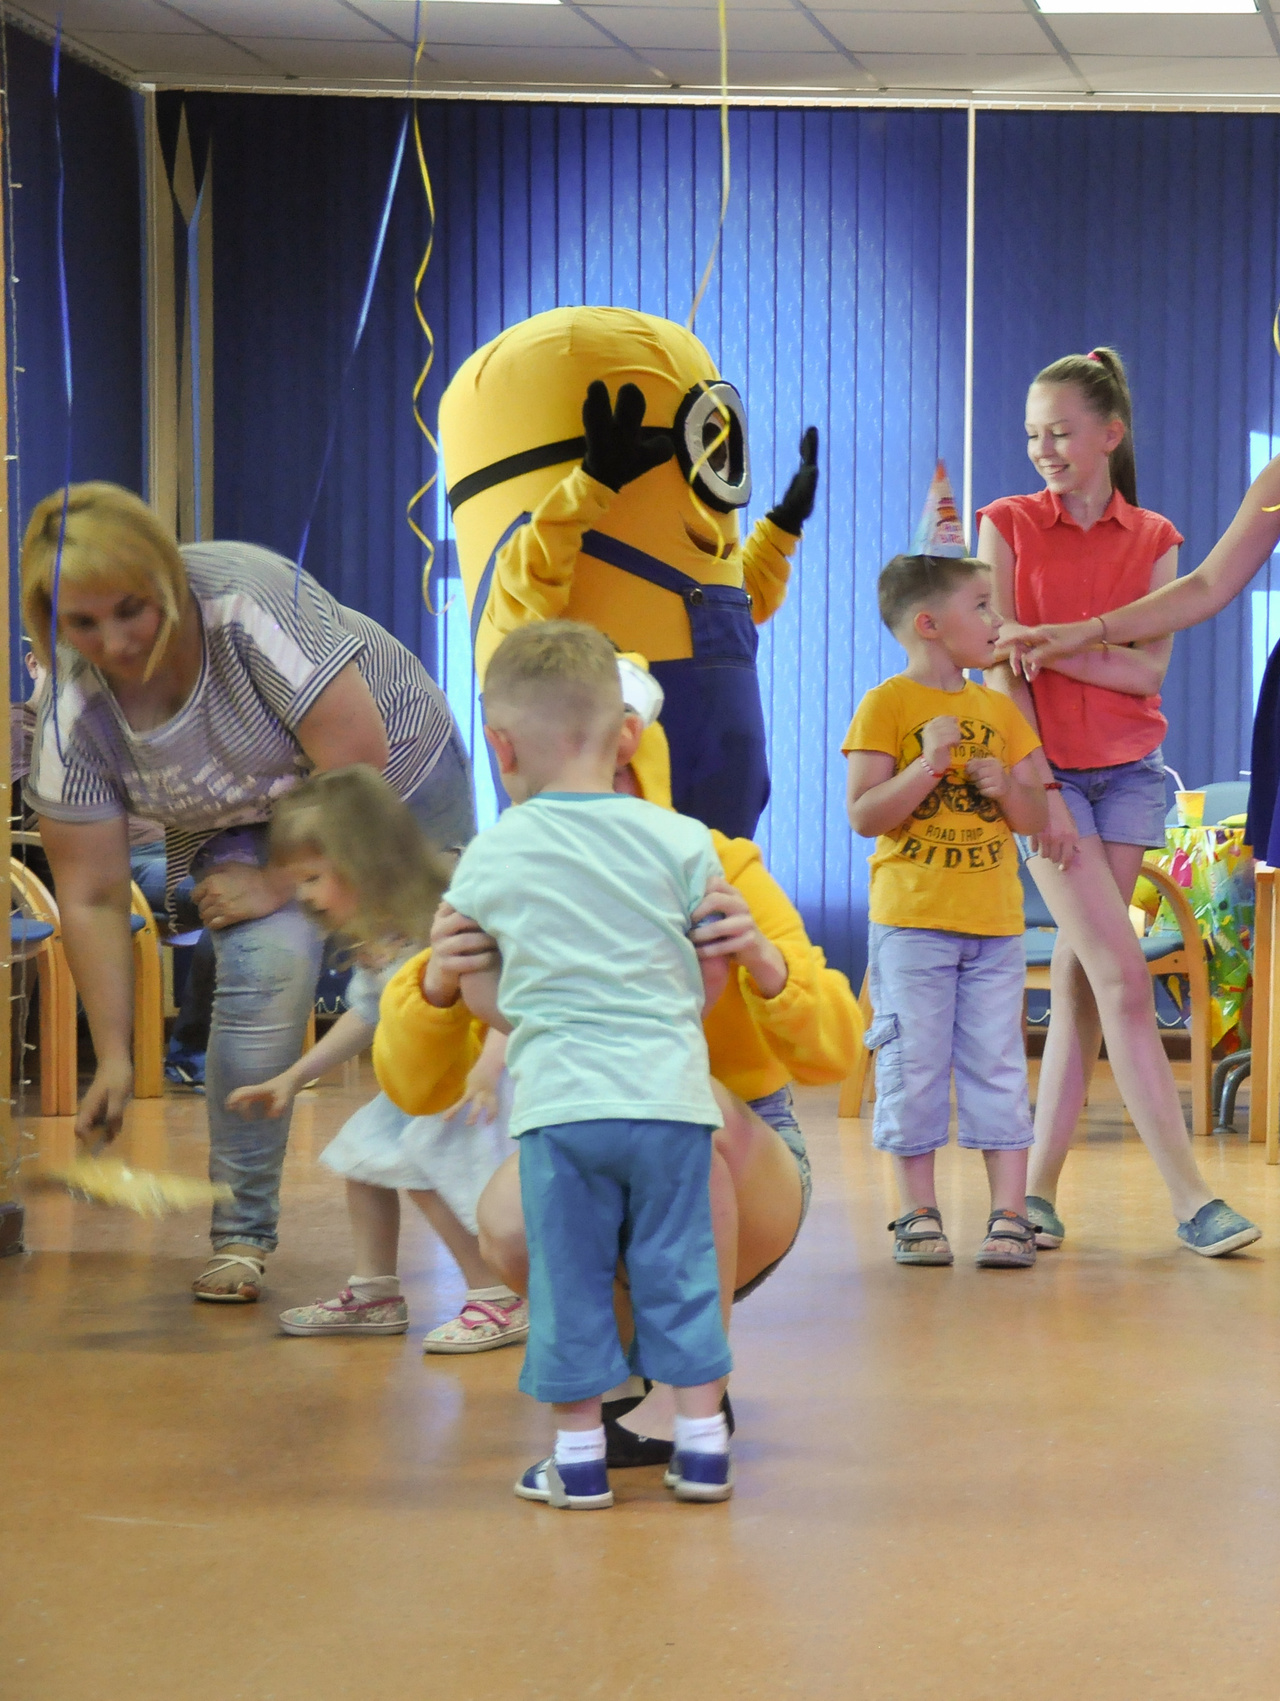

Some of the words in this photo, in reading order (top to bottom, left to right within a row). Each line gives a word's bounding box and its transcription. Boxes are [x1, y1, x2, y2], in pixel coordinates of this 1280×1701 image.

[926, 824, 956, 842] ROAD
[960, 827, 984, 842] TRIP
[899, 836, 1004, 869] RIDER
